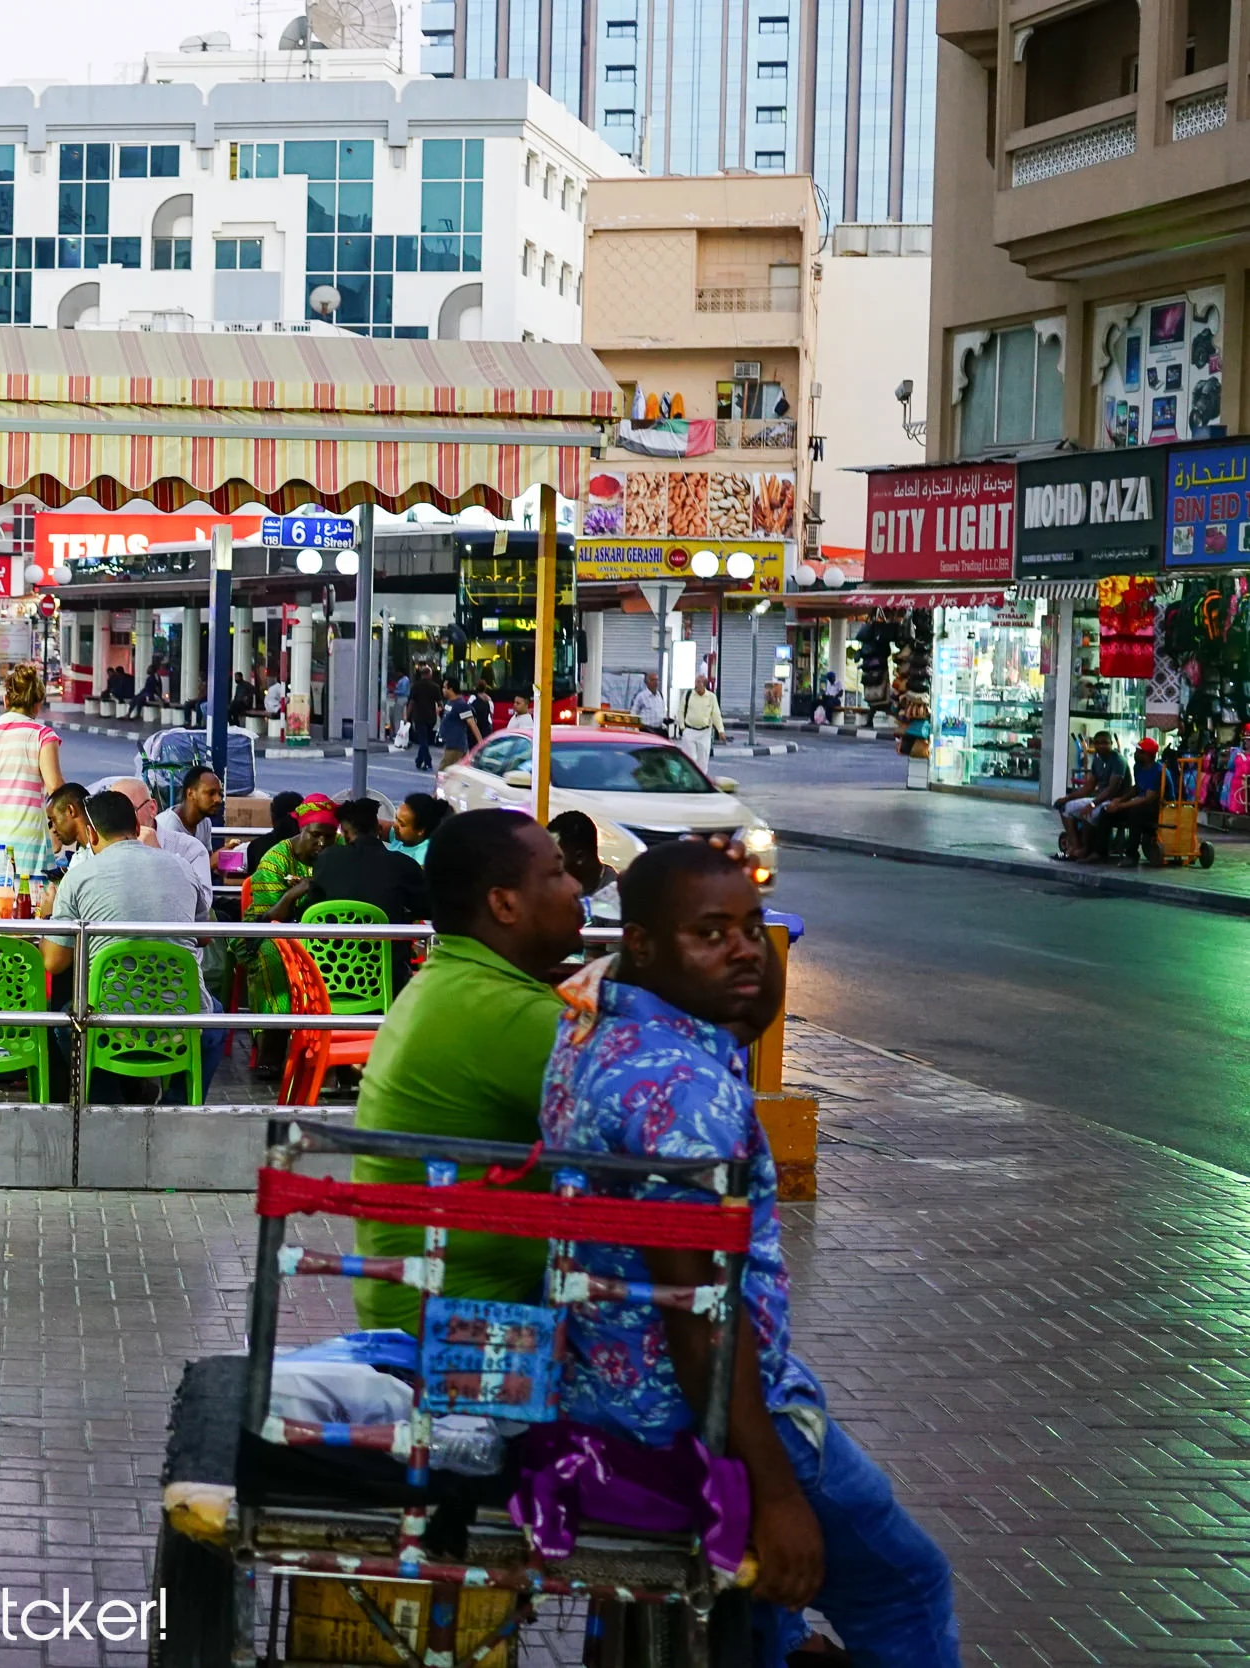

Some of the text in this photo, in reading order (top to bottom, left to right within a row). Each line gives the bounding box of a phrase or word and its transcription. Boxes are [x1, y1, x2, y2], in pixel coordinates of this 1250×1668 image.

[983, 473, 1013, 497] مدينة
[1175, 456, 1247, 492] للتجارة
[893, 479, 920, 499] العامة
[922, 476, 952, 502] للتجارة
[1024, 475, 1154, 530] MOHD RAZA
[1174, 494, 1207, 525] BIN
[1209, 492, 1241, 522] EID
[291, 520, 306, 544] 6
[323, 521, 353, 537] شارع
[871, 501, 1014, 554] CITY LIGHT
[47, 533, 150, 568] TEXAS
[263, 535, 279, 546] 118
[314, 535, 352, 548] a Street
[578, 546, 663, 563] ALI ASKARI GERASHI
